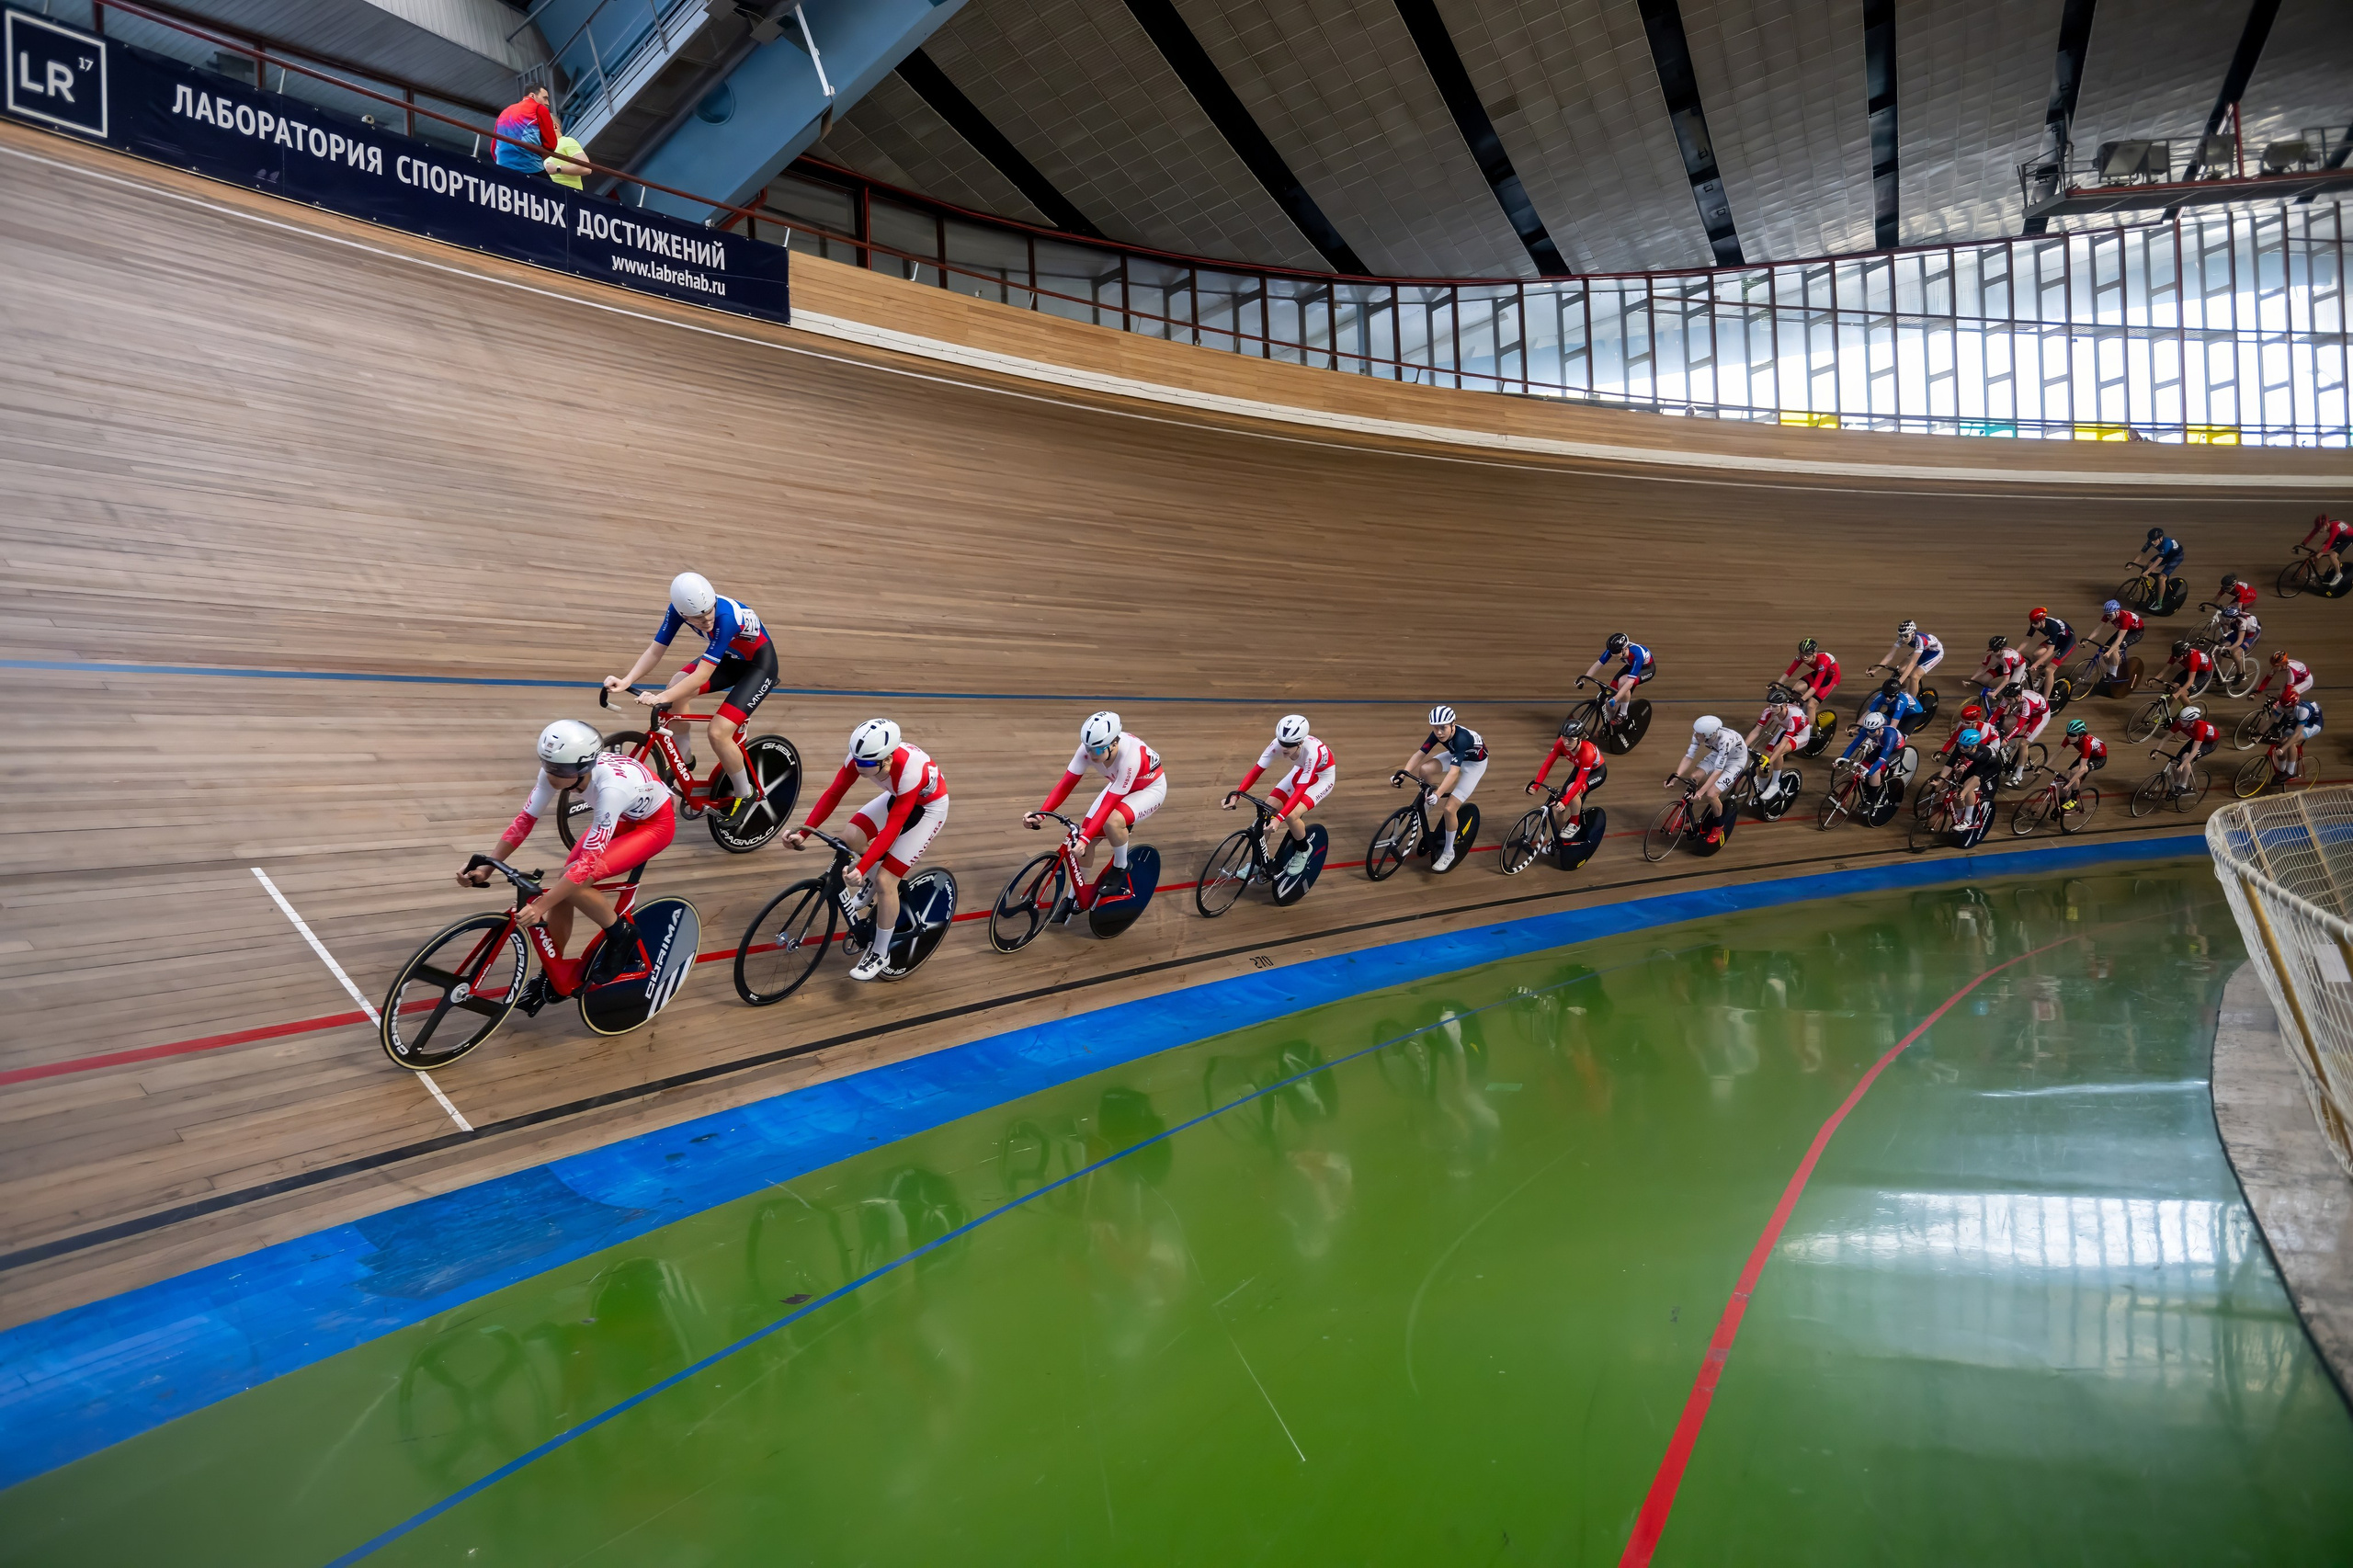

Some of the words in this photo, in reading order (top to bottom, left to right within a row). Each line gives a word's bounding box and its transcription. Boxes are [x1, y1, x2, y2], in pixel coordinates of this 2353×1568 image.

[19, 51, 75, 103] LR
[78, 57, 94, 72] 17
[172, 84, 383, 176] ЛАБОРАТОРИЯ
[396, 155, 567, 229] СПОРТИВНЫХ
[576, 208, 726, 271] ДОСТИЖЕНИЙ
[611, 255, 726, 297] www.labrehab.ru
[761, 742, 796, 766] GHIBLI
[1259, 835, 1270, 864] BMC
[838, 887, 860, 926] BMC
[505, 933, 525, 1004] CORIMA
[644, 908, 683, 1000] CORIMA
[1249, 955, 1274, 969] 270
